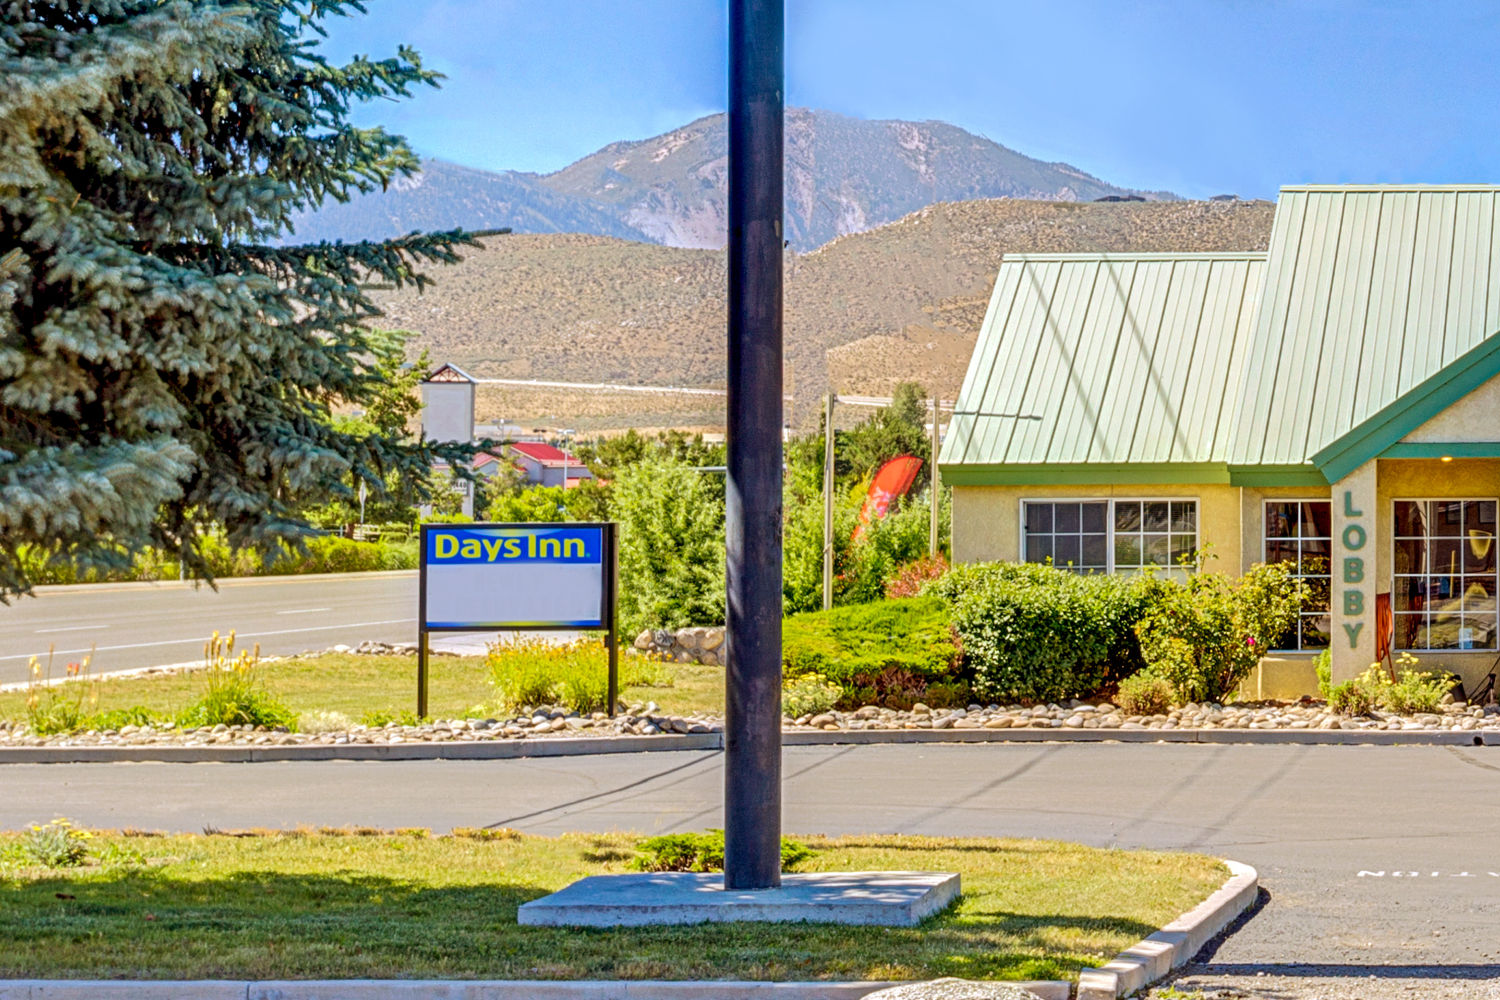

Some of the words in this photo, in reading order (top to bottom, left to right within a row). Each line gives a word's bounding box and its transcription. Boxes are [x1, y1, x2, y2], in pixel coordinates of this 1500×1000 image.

[435, 534, 521, 562] Days
[528, 534, 585, 558] Inn
[1342, 491, 1367, 649] LOBBY
